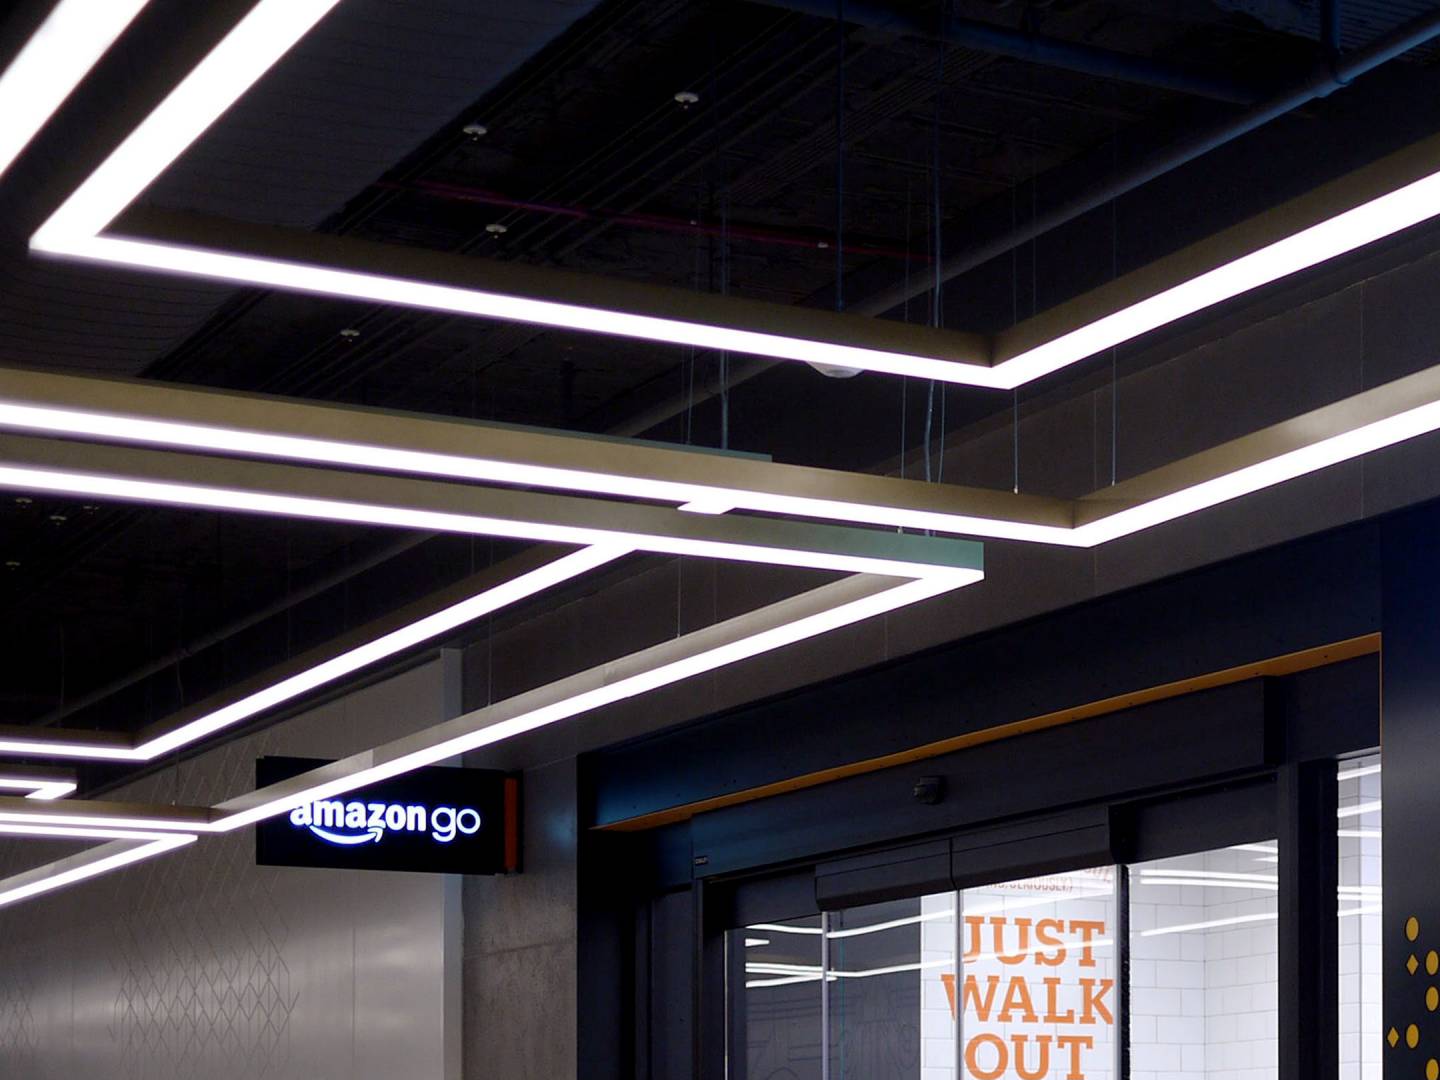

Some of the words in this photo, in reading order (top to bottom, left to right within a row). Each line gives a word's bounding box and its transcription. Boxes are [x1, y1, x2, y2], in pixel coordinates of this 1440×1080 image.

[290, 800, 427, 832] amazon
[431, 807, 481, 842] go
[963, 915, 1105, 968] JUST
[941, 974, 1114, 1025] WALK
